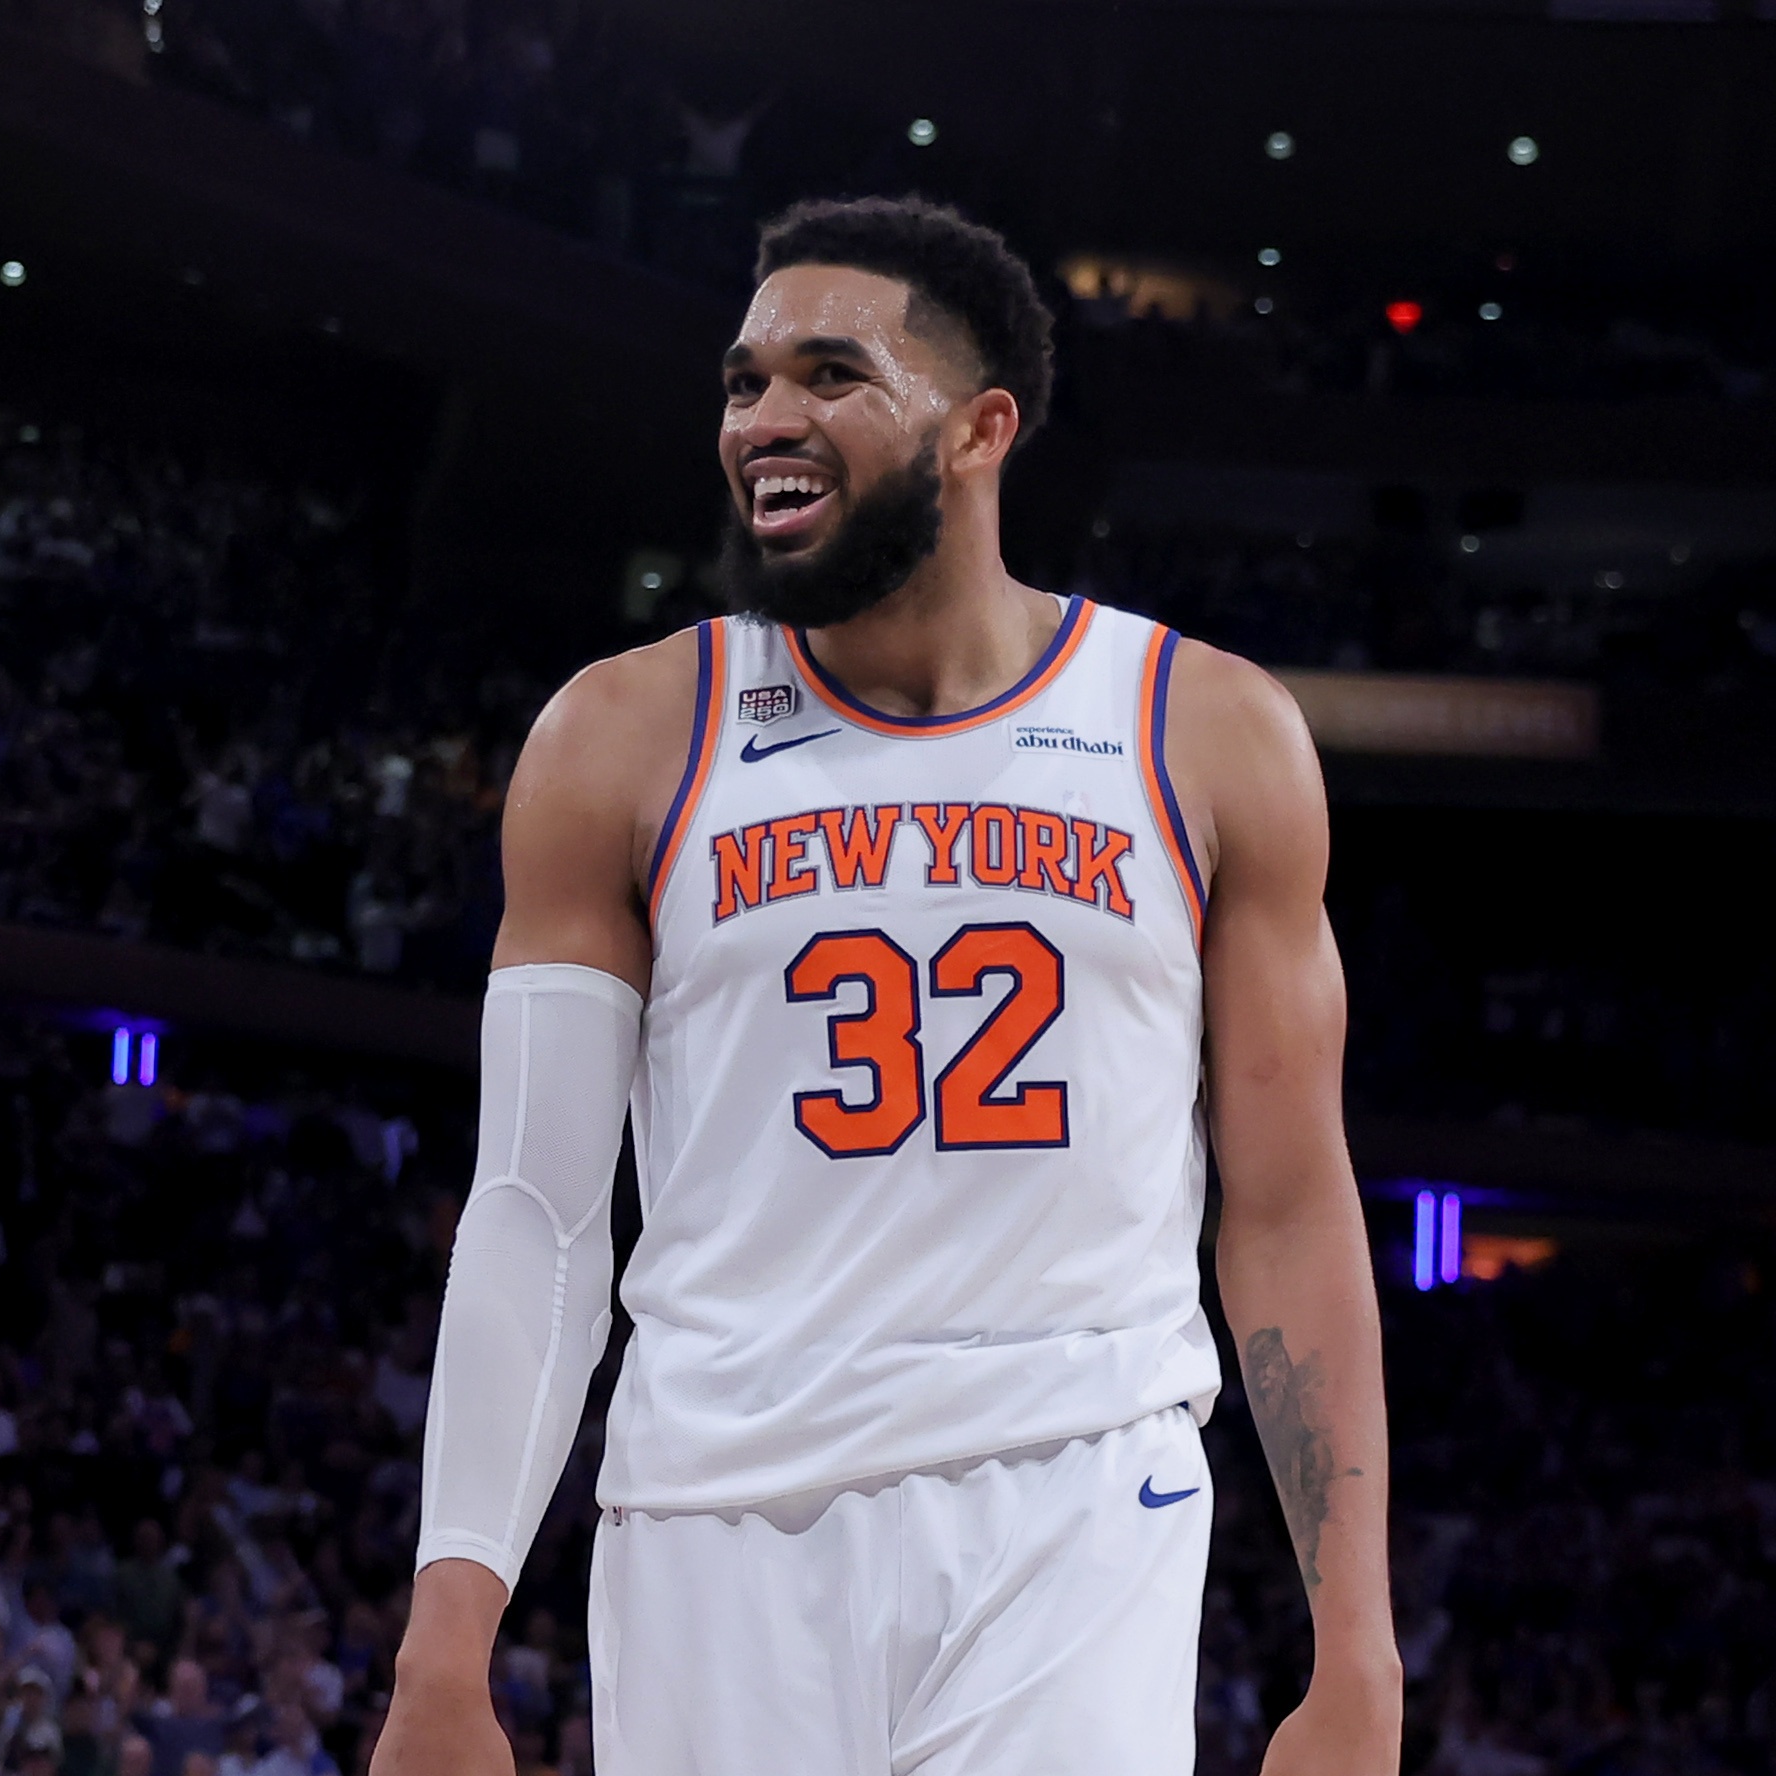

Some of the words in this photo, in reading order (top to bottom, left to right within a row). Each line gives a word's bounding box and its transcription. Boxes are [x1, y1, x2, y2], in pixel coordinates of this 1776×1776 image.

[742, 689, 787, 702] USA
[739, 703, 790, 719] 250
[1016, 726, 1074, 735] experience
[1015, 734, 1058, 749] abu
[1061, 736, 1124, 756] dhabi
[710, 802, 905, 927] NEW
[910, 801, 1135, 926] YORK
[784, 921, 1070, 1159] 32
